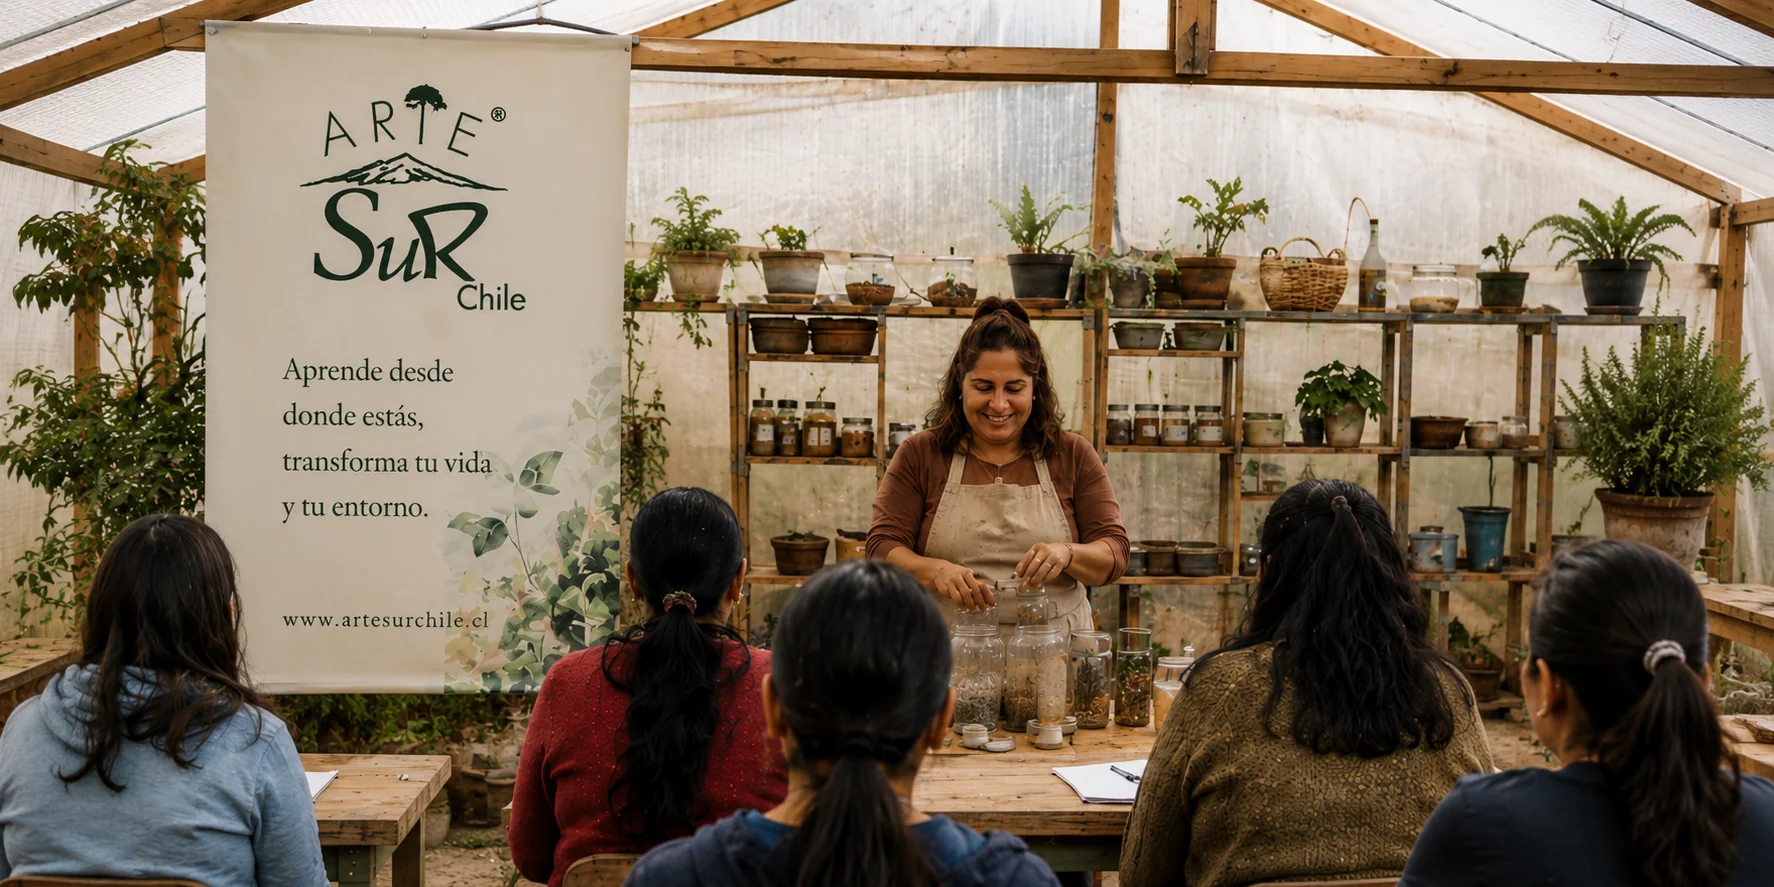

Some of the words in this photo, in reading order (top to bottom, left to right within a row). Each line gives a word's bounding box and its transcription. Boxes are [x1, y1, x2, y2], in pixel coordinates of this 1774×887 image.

[457, 281, 526, 311] Chile
[282, 358, 382, 387] Aprende
[390, 358, 453, 382] desde
[283, 402, 356, 426] donde
[362, 405, 424, 431] estás,
[283, 448, 408, 472] transforma
[415, 456, 438, 472] tu
[444, 450, 492, 473] vida
[282, 502, 295, 523] y
[302, 500, 325, 516] tu
[332, 500, 428, 517] entorno.
[283, 611, 488, 628] www.artesurchile.cl
